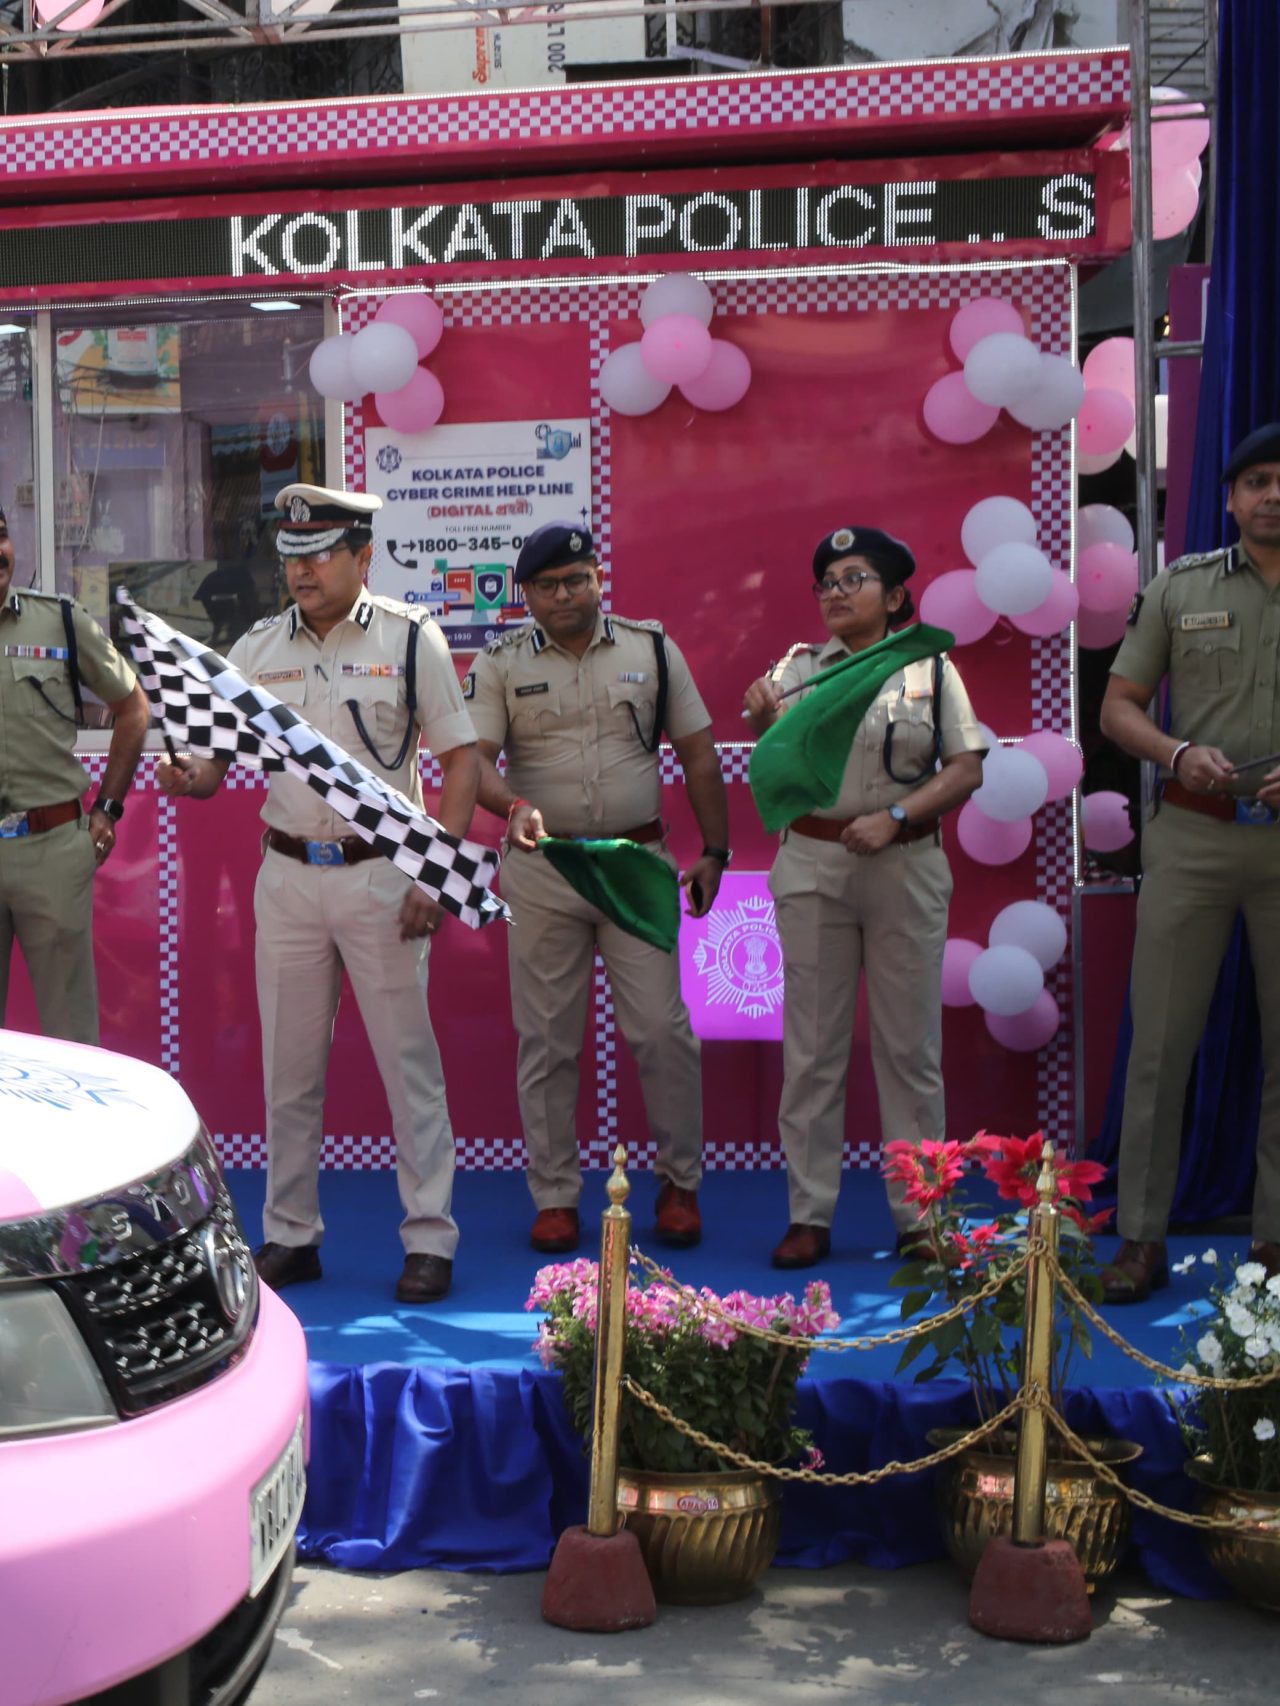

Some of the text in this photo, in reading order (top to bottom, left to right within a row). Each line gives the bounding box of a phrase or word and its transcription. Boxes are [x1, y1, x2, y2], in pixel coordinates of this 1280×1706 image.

[547, 42, 565, 73] 200
[231, 198, 594, 277] KOLKATA
[625, 182, 937, 258] POLICE
[1037, 172, 1096, 241] S
[412, 465, 545, 482] KOLKATA POLICE
[386, 482, 574, 501] CYBER CRIME HELP LINE
[427, 503, 493, 519] (DIGITAL
[463, 525, 479, 533] FREE
[481, 523, 511, 532] NUMBER
